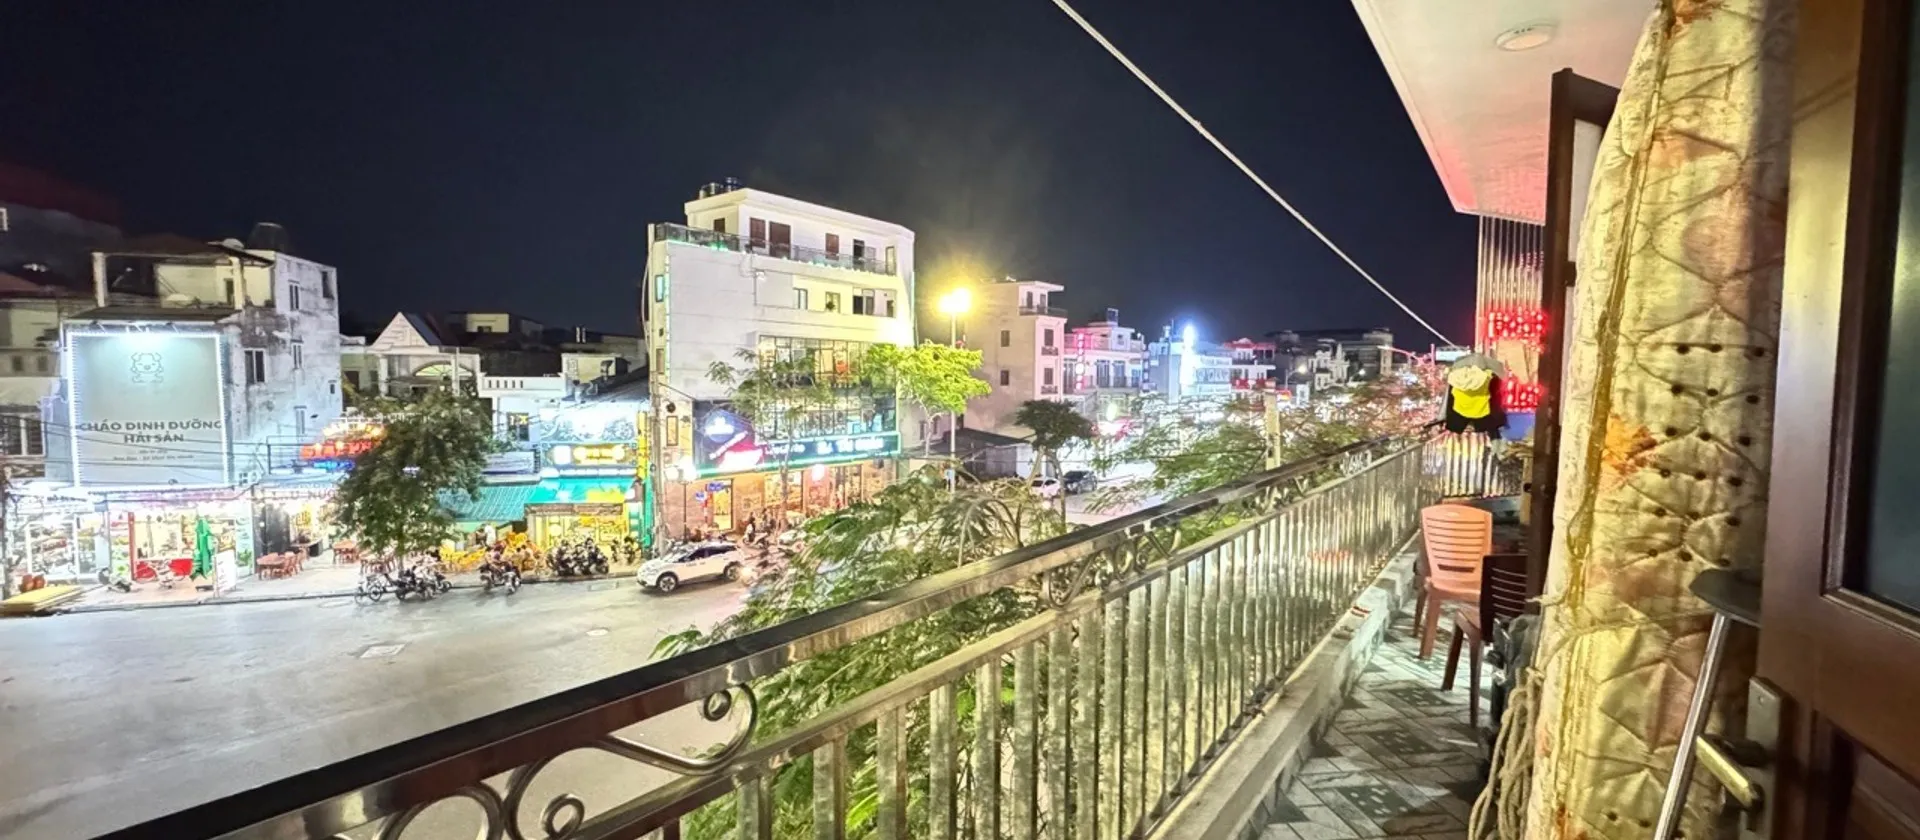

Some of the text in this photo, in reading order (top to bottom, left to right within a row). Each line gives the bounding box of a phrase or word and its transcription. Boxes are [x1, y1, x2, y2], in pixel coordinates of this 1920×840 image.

[80, 419, 122, 431] CHÁO
[125, 421, 165, 431] DINH
[153, 430, 184, 443] SẢN
